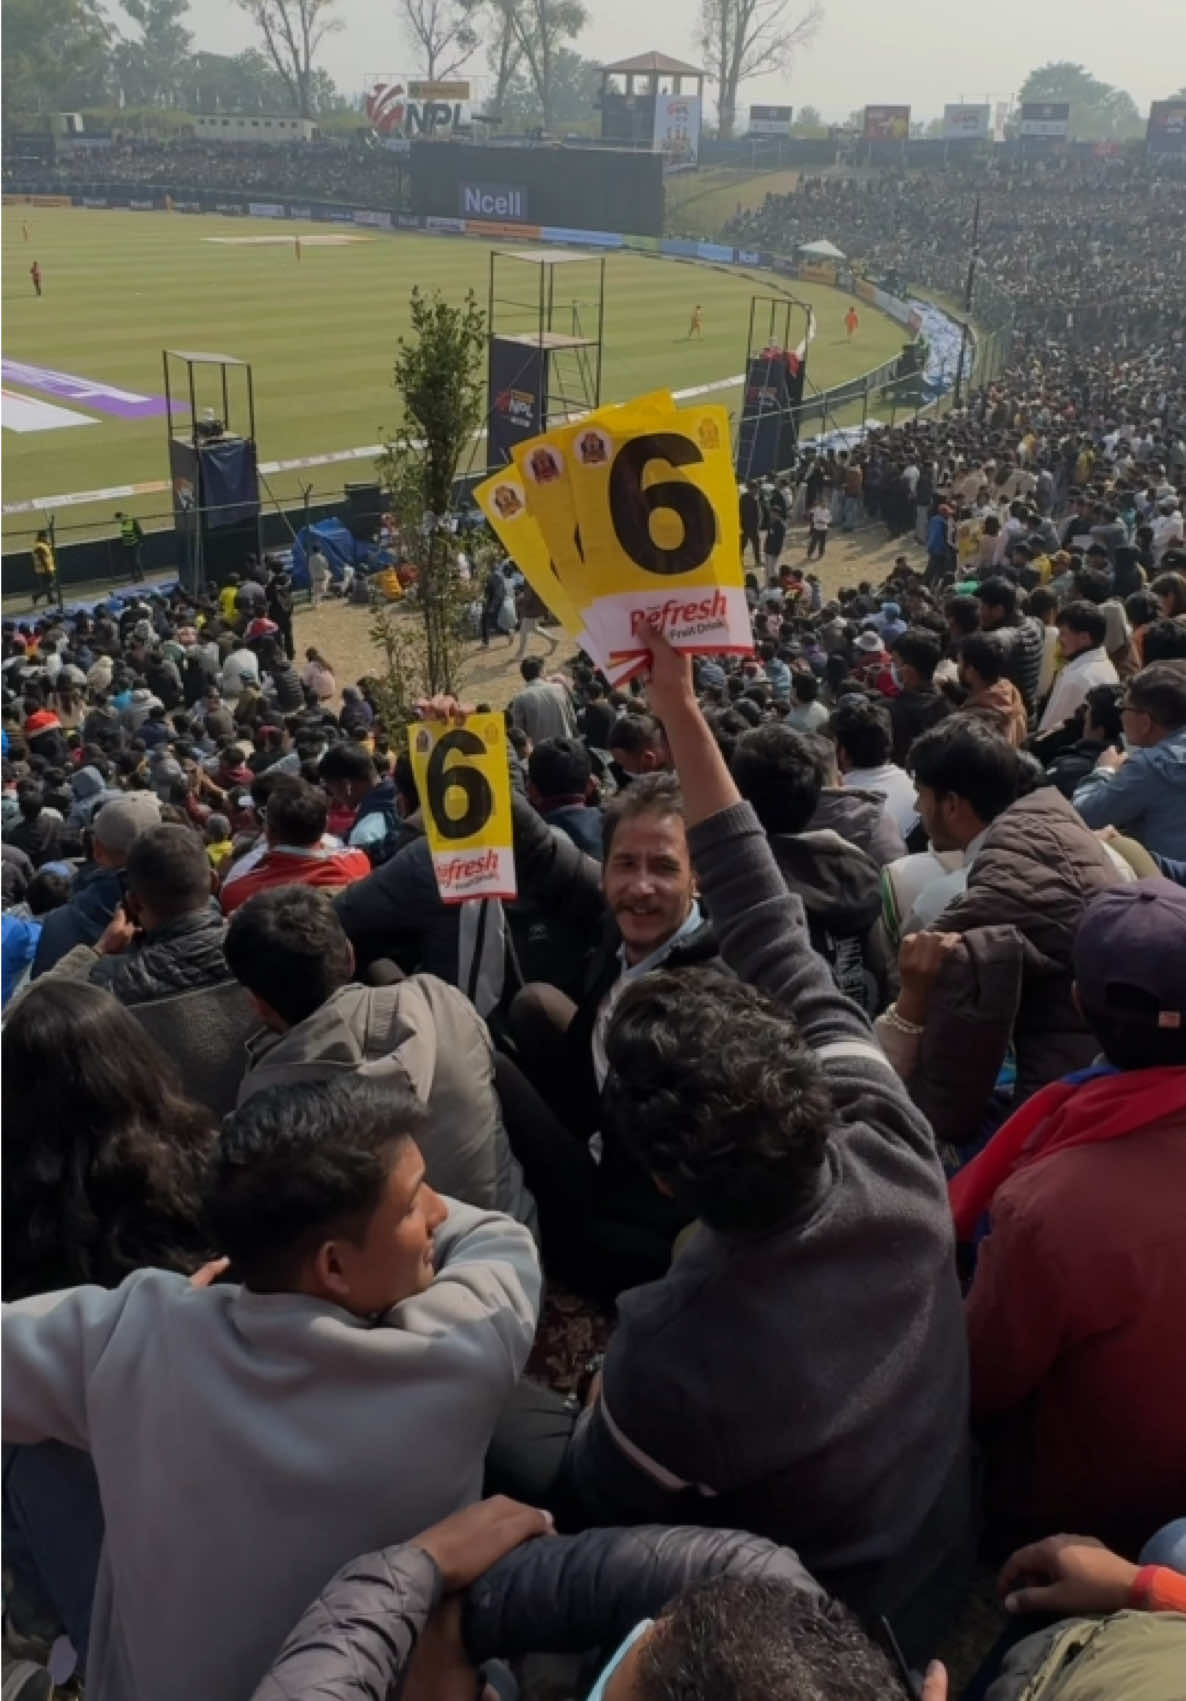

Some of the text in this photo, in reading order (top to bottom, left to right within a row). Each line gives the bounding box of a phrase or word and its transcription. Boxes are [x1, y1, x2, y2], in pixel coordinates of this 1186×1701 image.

[404, 103, 471, 134] NPL
[464, 187, 521, 217] Ncell
[608, 433, 717, 575] 6
[630, 588, 728, 637] Refresh
[427, 729, 493, 840] 6
